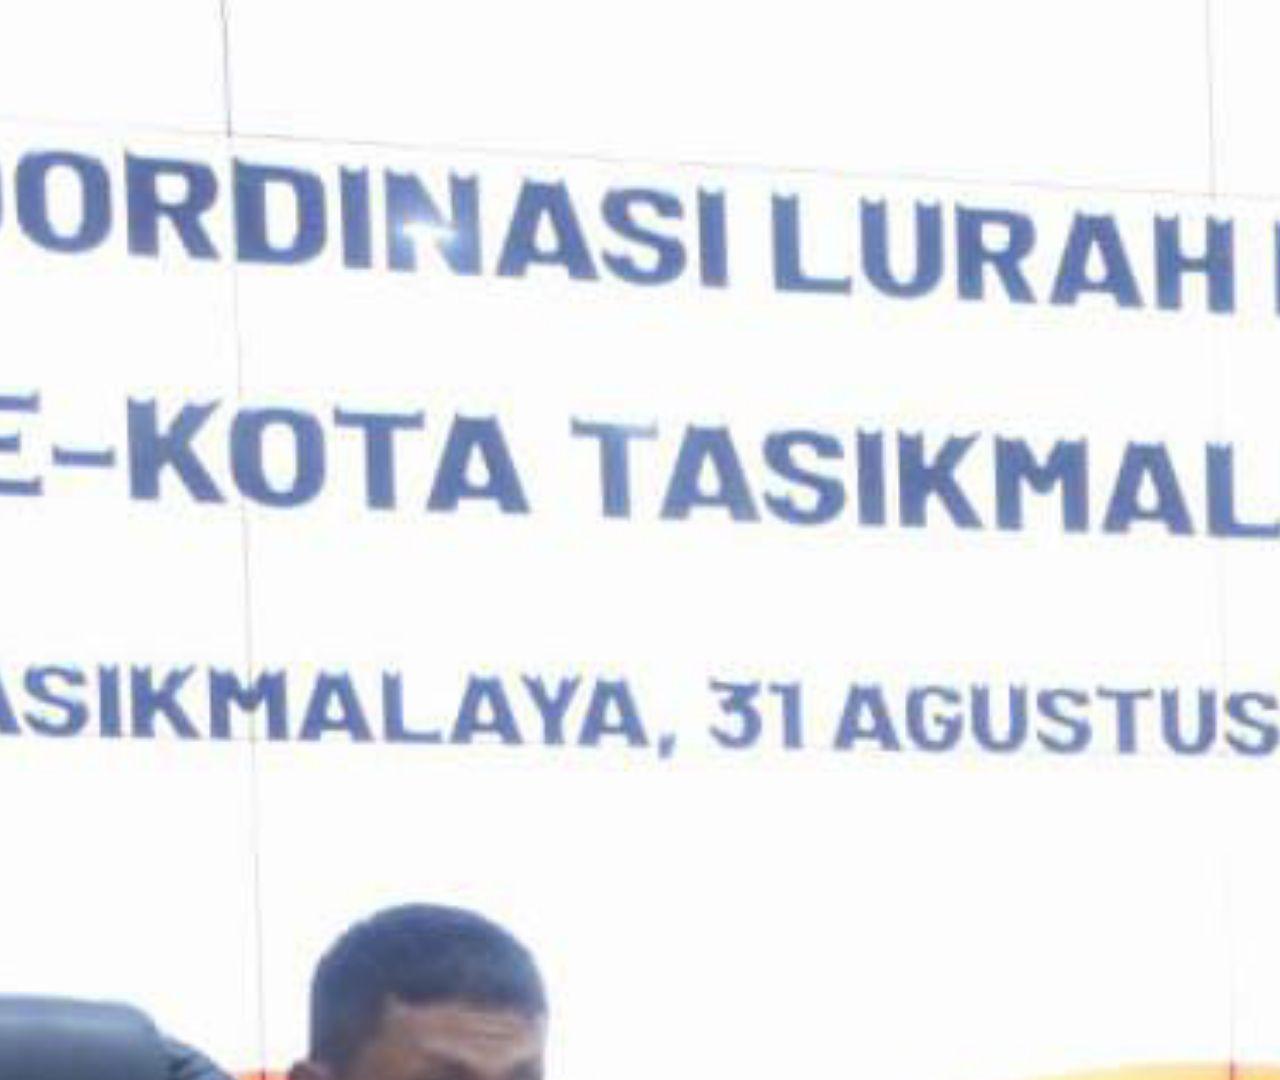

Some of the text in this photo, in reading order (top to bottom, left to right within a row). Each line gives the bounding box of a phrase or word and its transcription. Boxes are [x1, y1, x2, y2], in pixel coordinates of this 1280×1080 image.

[0, 150, 730, 289] ORDINASI
[770, 192, 1237, 315] LURAH
[708, 678, 805, 751] 31
[832, 682, 1280, 758] AGUSTUS
